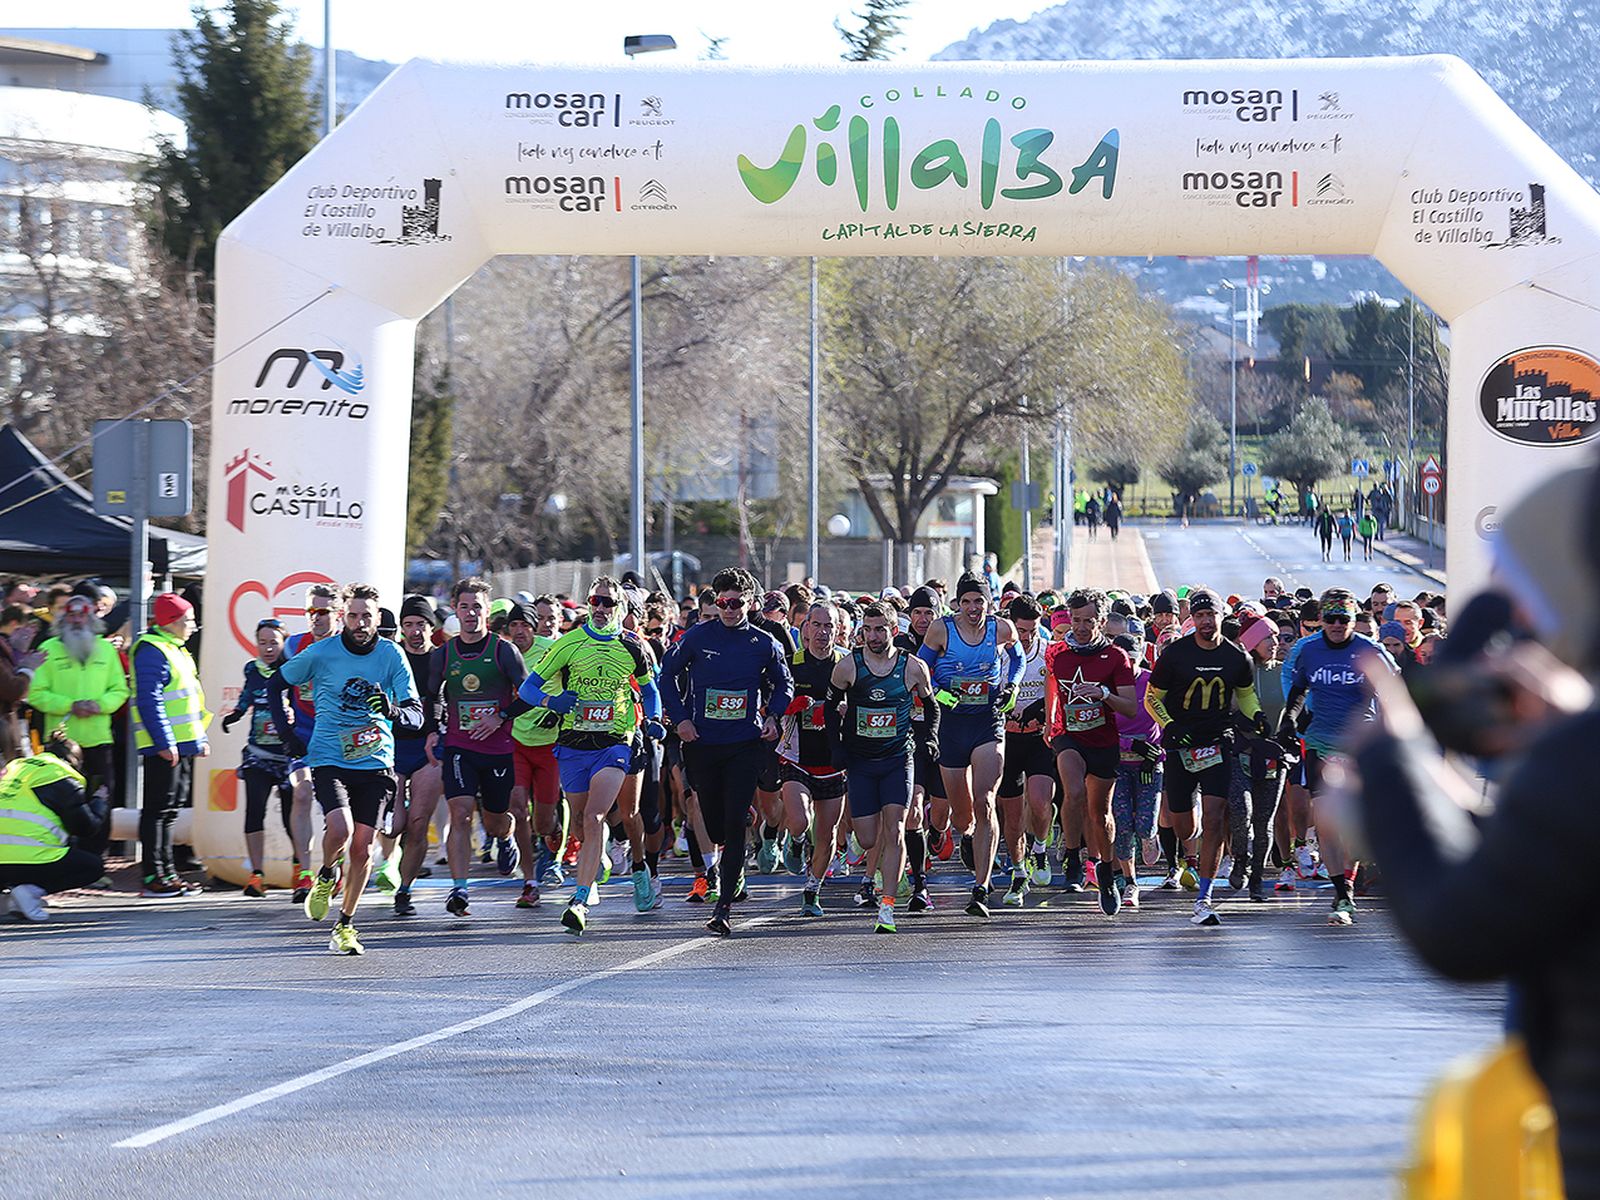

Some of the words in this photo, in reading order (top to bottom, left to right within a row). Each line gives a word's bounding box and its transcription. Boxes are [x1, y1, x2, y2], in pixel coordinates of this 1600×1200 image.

[506, 93, 605, 109] mosan
[861, 86, 1026, 110] COLLADO
[1183, 90, 1283, 105] mosan
[558, 110, 605, 127] car
[1236, 106, 1283, 122] car
[505, 176, 606, 195] mosan
[1182, 171, 1283, 190] mosan
[307, 185, 337, 199] Club
[341, 185, 418, 200] Deportivo
[1236, 191, 1283, 207] car
[1411, 188, 1443, 204] Club
[1449, 187, 1524, 205] Deportivo
[304, 203, 317, 217] El
[321, 204, 376, 218] Castillo
[559, 196, 606, 212] car
[1412, 209, 1425, 224] El
[1429, 207, 1484, 224] Castillo
[302, 222, 322, 236] de
[327, 223, 386, 238] Villalba
[939, 226, 959, 236] LA
[962, 221, 1037, 241] SIERRA
[1414, 229, 1433, 243] de
[1437, 228, 1493, 243] Villalba
[1515, 384, 1541, 400] Las
[226, 399, 370, 419] morenito
[1496, 397, 1597, 422] Murallas
[275, 482, 340, 498] mesón
[250, 492, 363, 520] CASTILLO
[720, 698, 744, 709] 339
[588, 708, 610, 720] 148
[870, 715, 894, 727] 567
[1078, 709, 1100, 721] 393
[1195, 746, 1217, 759] 225
